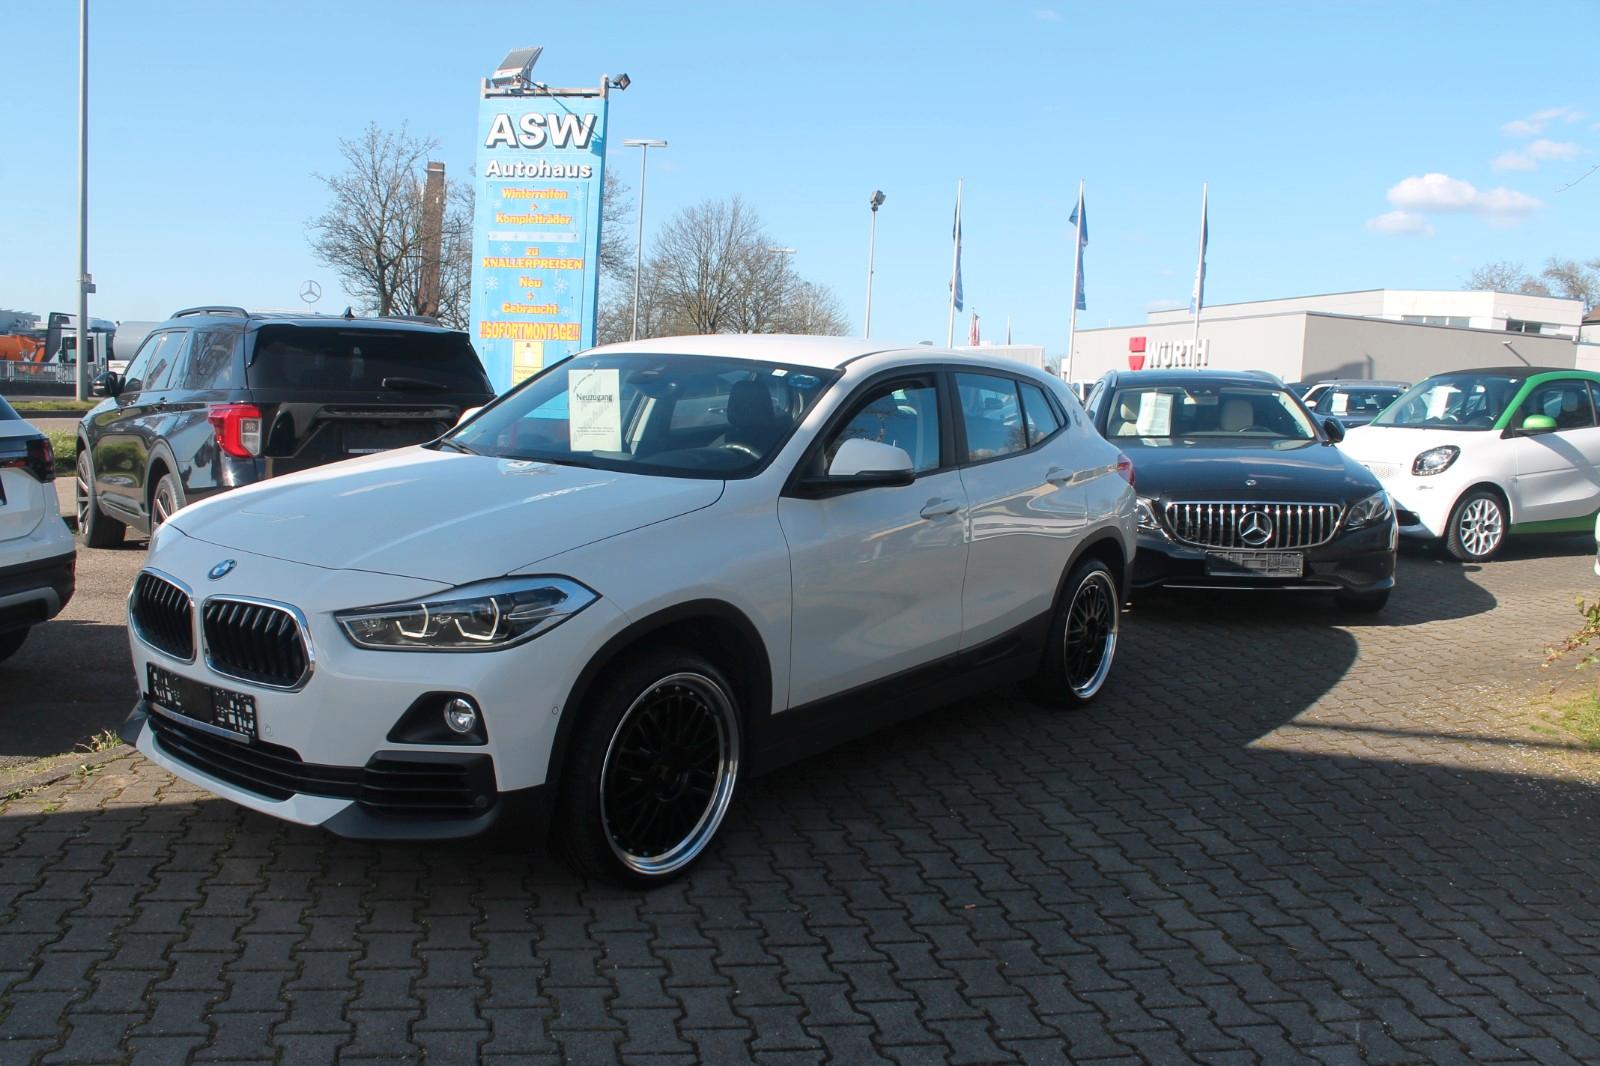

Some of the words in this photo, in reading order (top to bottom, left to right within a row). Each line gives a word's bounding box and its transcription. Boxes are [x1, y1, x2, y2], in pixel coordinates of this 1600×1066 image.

[485, 112, 598, 149] ASW
[485, 159, 592, 178] Autohaus
[502, 188, 568, 200] Winterreifen
[496, 212, 572, 225] Kompletträder
[482, 258, 584, 269] KNALLERPREISEN
[519, 277, 542, 288] Neu
[501, 303, 558, 315] Gebraucht
[576, 393, 613, 403] Neuzugang
